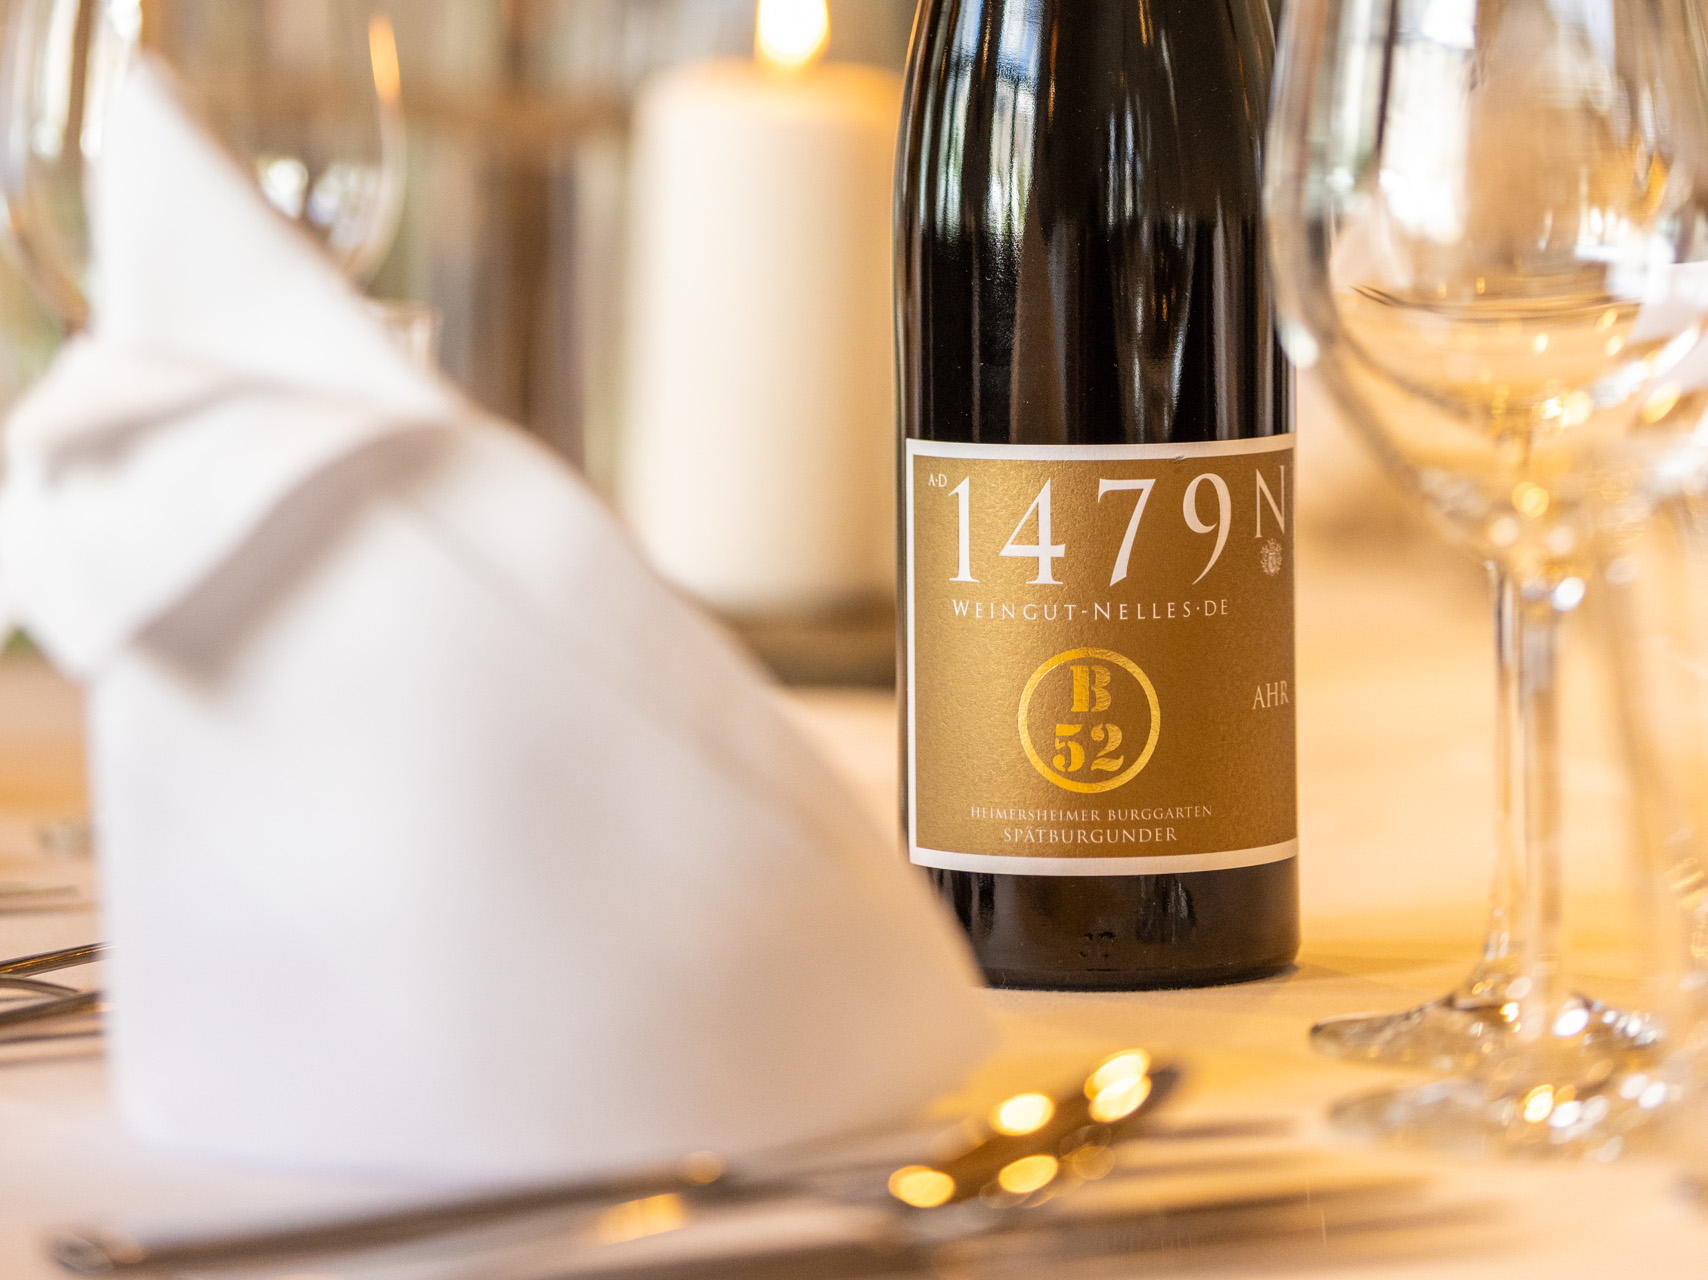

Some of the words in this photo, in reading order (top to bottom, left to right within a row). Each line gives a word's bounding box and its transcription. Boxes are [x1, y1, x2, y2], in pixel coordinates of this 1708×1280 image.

[1255, 465, 1285, 538] N
[948, 473, 1232, 586] 1479
[1070, 665, 1112, 713] B
[1252, 680, 1289, 710] AHR
[1052, 723, 1124, 773] 52
[971, 805, 1101, 822] HEIMERSHEIMER
[1108, 804, 1213, 821] BURGGARTEN
[1003, 827, 1178, 845] SPÄTBURGUNDER
